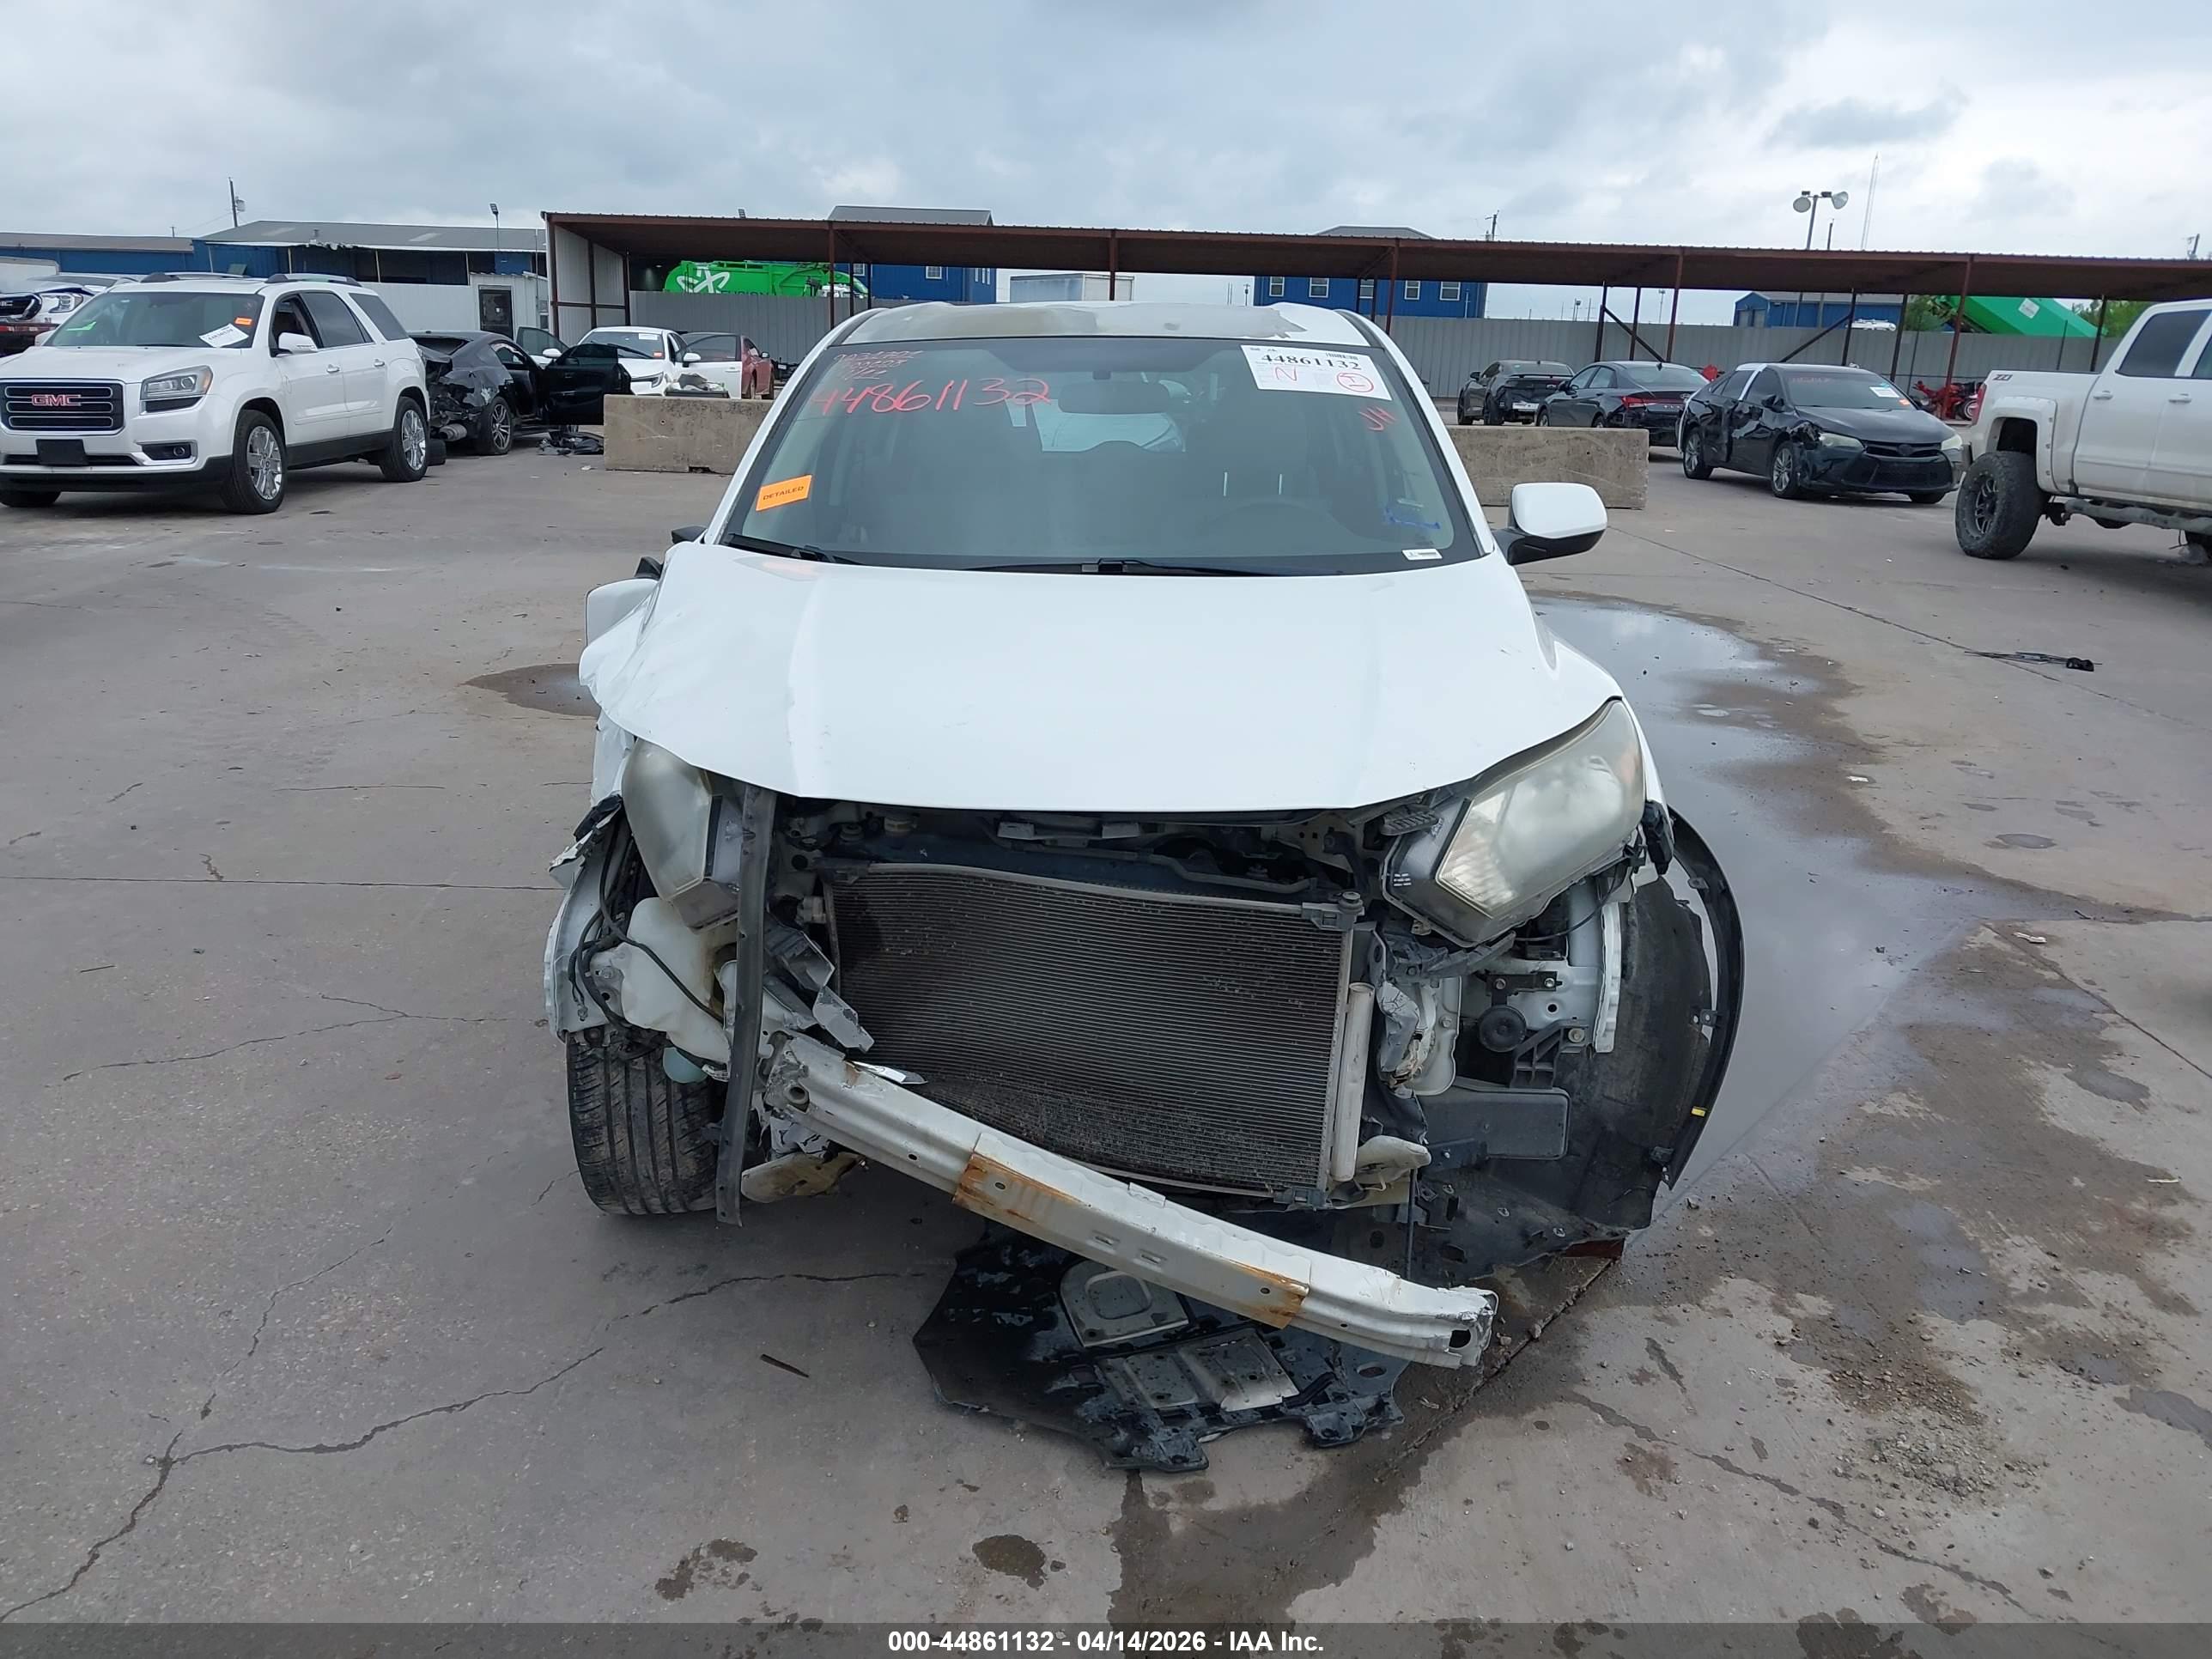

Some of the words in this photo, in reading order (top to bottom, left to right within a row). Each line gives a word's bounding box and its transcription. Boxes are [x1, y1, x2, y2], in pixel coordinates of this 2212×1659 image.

[1262, 355, 1362, 369] 44861132
[31, 394, 82, 406] GMC
[763, 486, 804, 500] DETAILED
